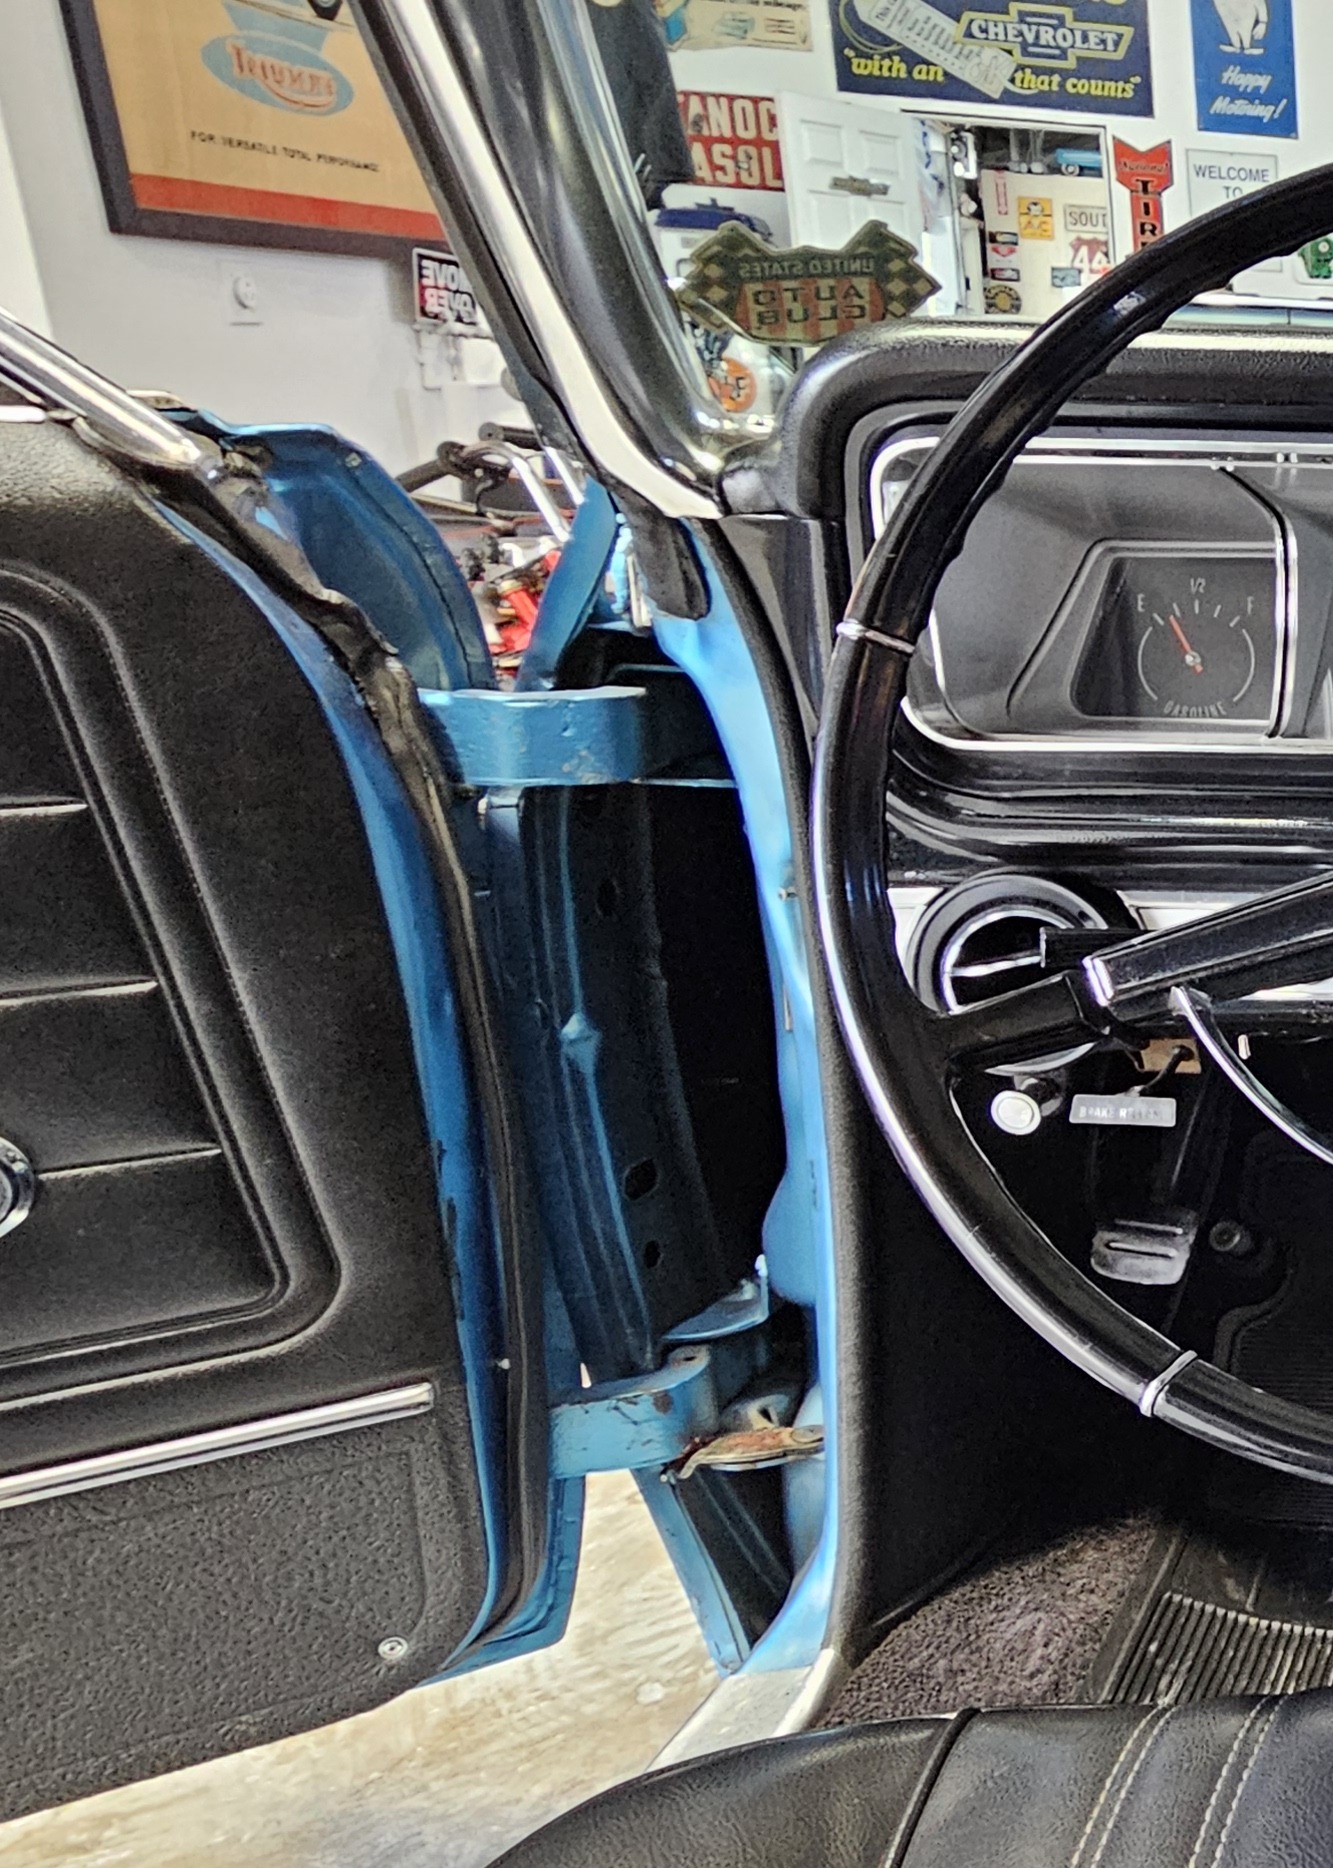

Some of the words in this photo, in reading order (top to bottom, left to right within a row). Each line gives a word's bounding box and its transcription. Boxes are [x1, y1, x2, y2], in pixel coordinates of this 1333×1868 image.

[970, 19, 1118, 51] CHEVROLET
[912, 64, 945, 82] an
[1014, 68, 1059, 91] that
[1221, 65, 1272, 94] Happy
[678, 92, 778, 141] ANOC
[1209, 96, 1288, 123] Motoring!
[1193, 163, 1270, 183] WELCOME
[1223, 186, 1244, 199] TO
[1137, 593, 1146, 613] E
[1246, 596, 1256, 615] F
[1163, 700, 1227, 717] GASOLINE
